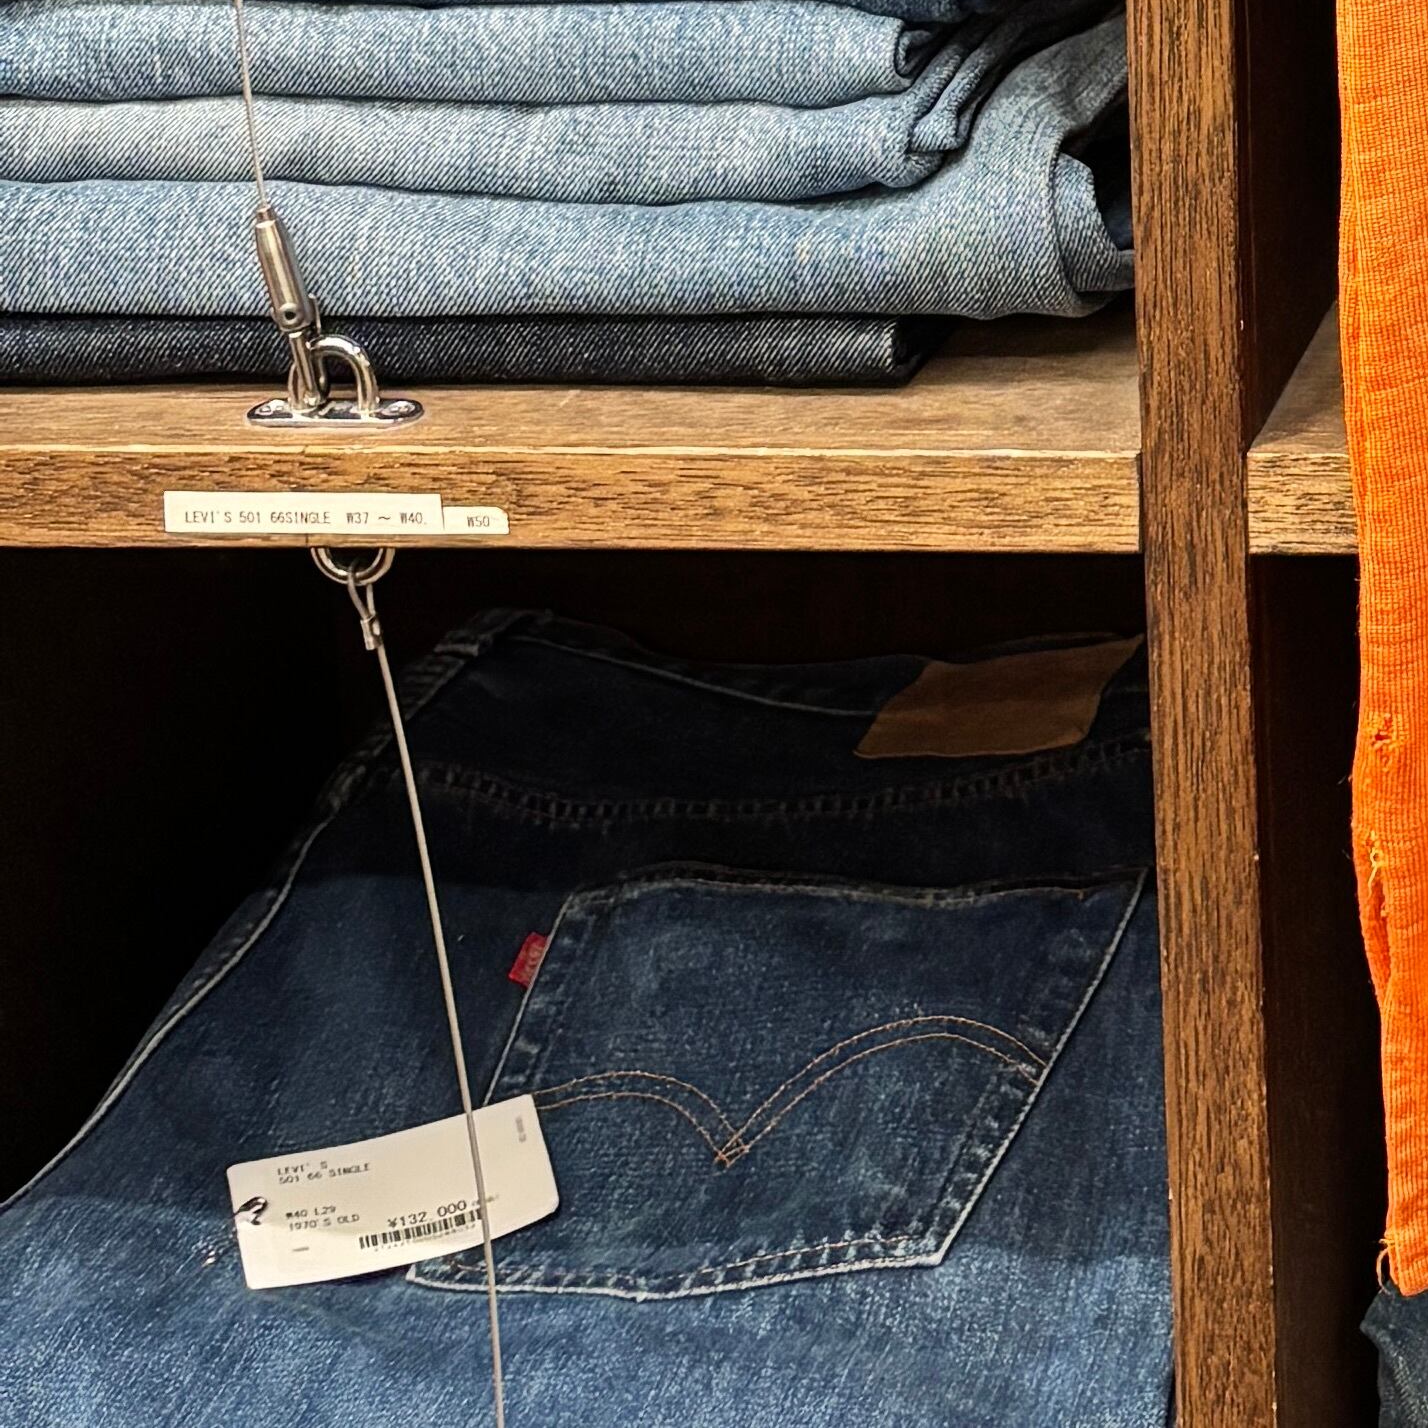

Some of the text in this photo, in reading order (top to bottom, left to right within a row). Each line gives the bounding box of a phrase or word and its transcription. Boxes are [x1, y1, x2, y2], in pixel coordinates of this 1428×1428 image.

[184, 510, 233, 524] LEVI'S
[239, 510, 261, 524] 501
[269, 510, 331, 525] 66SINGLE
[346, 511, 370, 525] W37
[466, 514, 491, 528] W50
